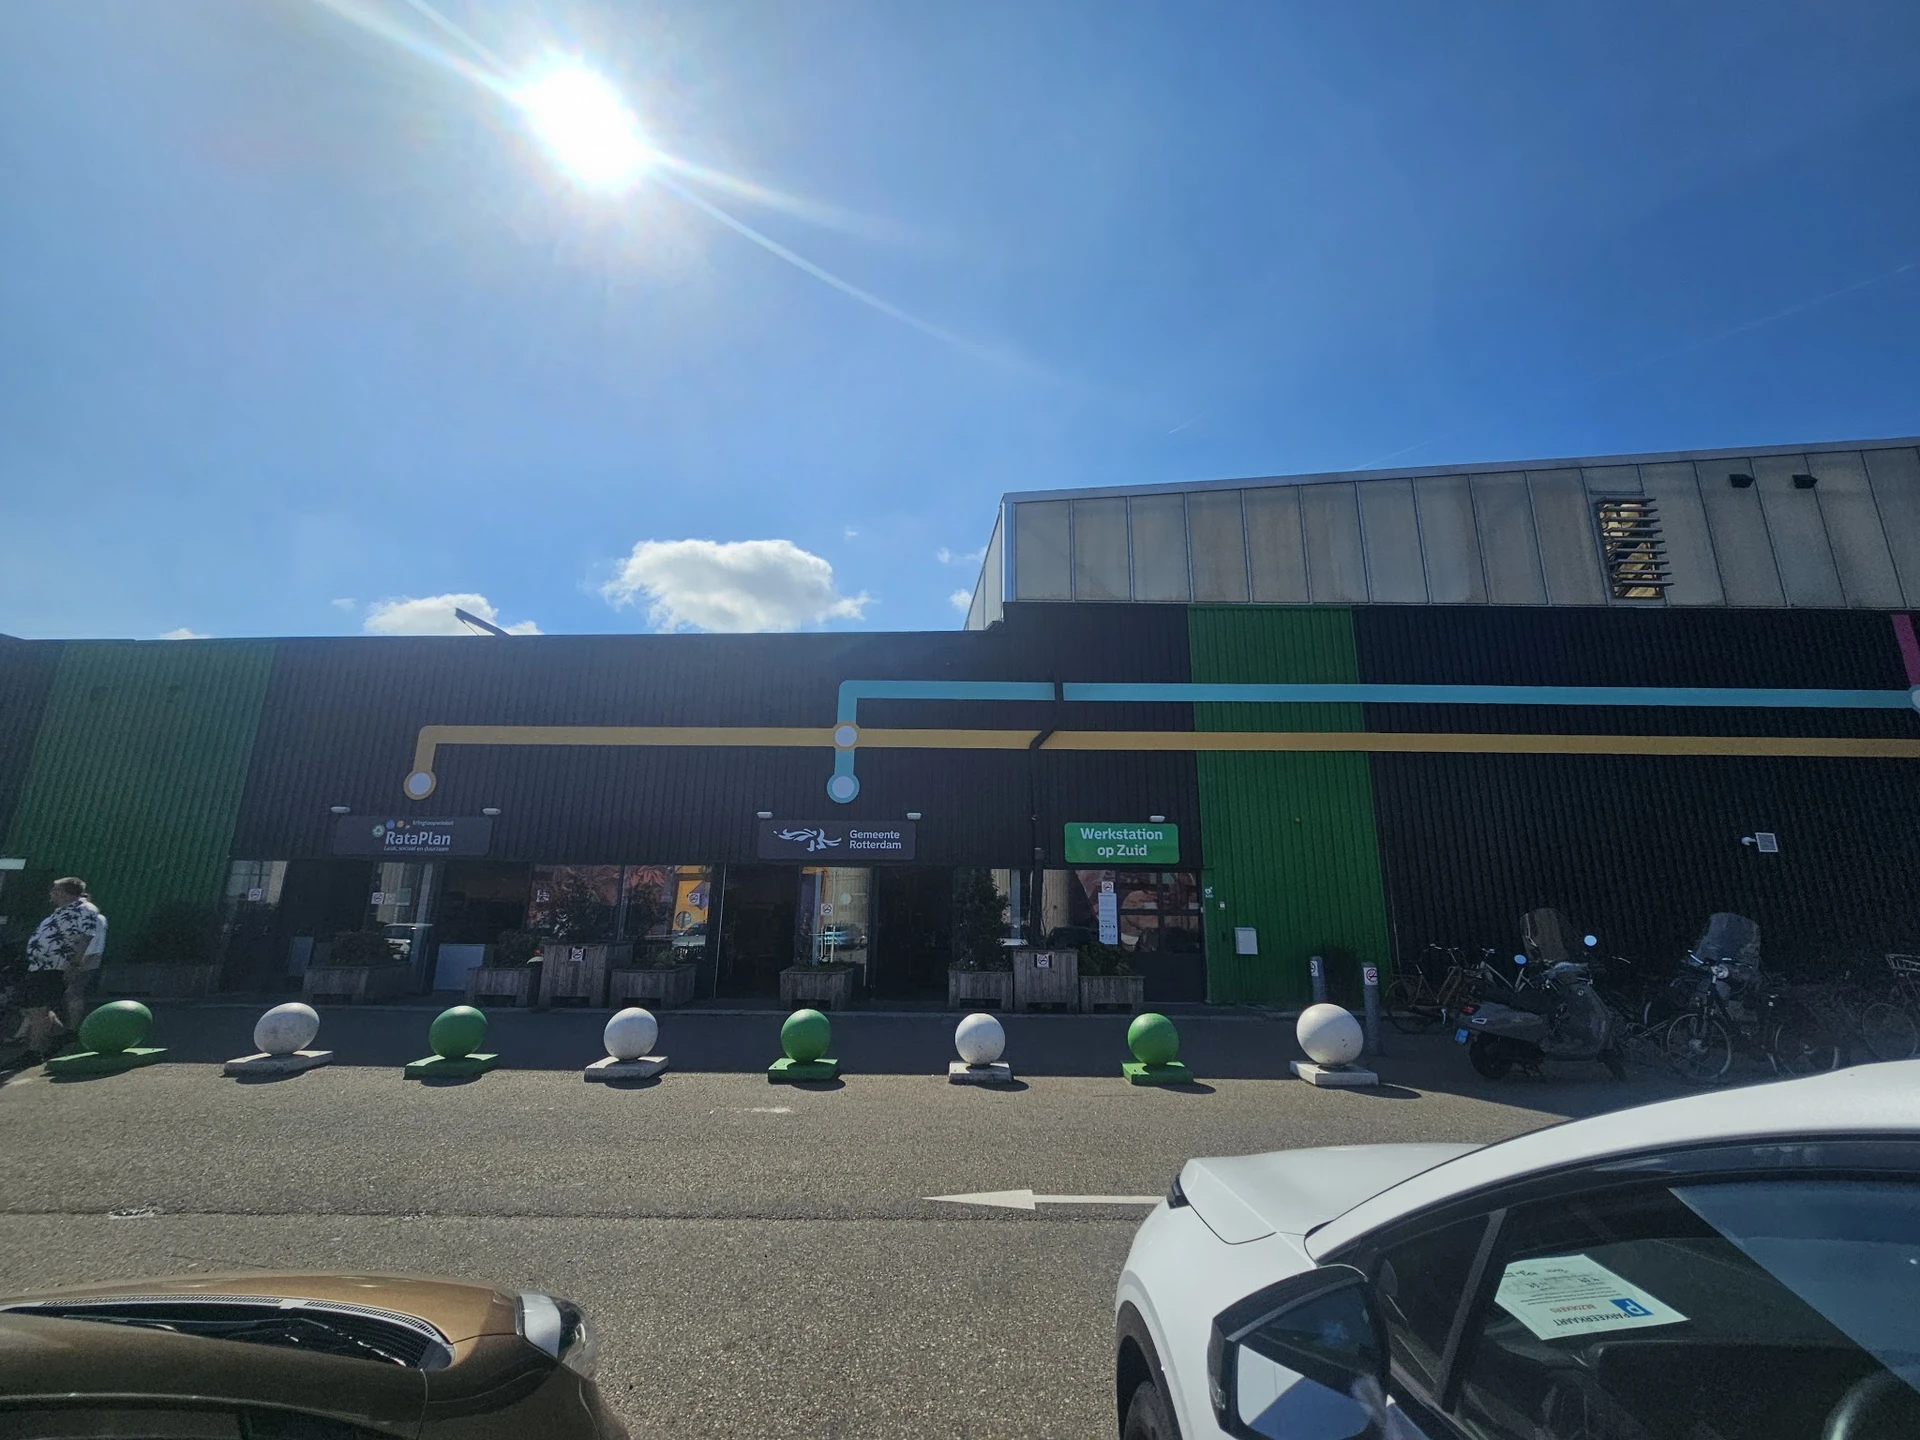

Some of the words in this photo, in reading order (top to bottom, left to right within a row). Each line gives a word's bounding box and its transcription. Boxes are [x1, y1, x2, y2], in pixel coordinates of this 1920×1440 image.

[385, 831, 451, 845] RataPlan
[849, 829, 900, 839] Gemeente
[1080, 827, 1163, 840] Werkstation
[849, 840, 902, 849] Rotterdam
[1097, 845, 1114, 858] op
[1116, 844, 1148, 856] Zuid
[1550, 1303, 1597, 1314] BEZOEKERS
[1552, 1312, 1629, 1327] PARKEERKAART
